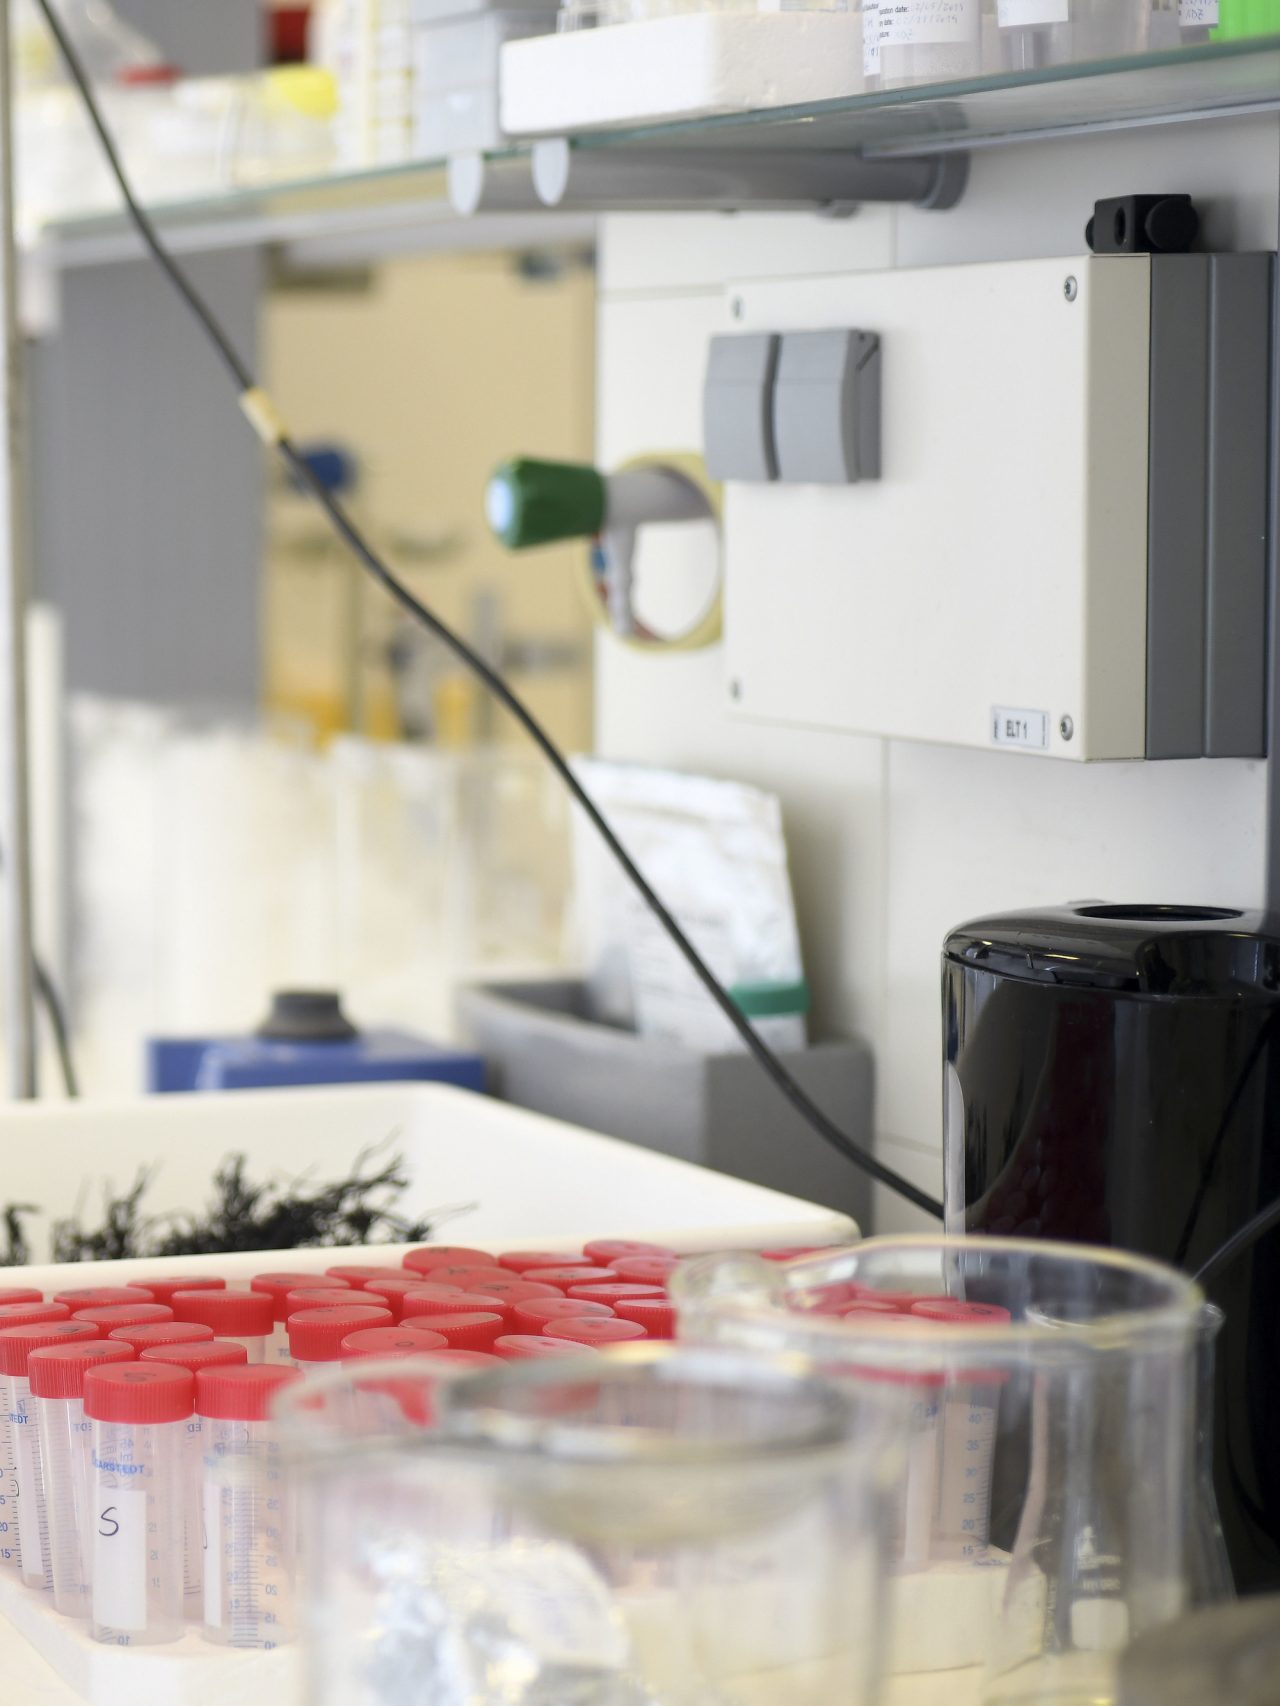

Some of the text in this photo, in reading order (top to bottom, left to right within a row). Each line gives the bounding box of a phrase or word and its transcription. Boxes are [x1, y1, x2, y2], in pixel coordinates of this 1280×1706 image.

[1006, 720, 1021, 737] ELT
[98, 1506, 119, 1537] S
[0, 1548, 11, 1559] 15
